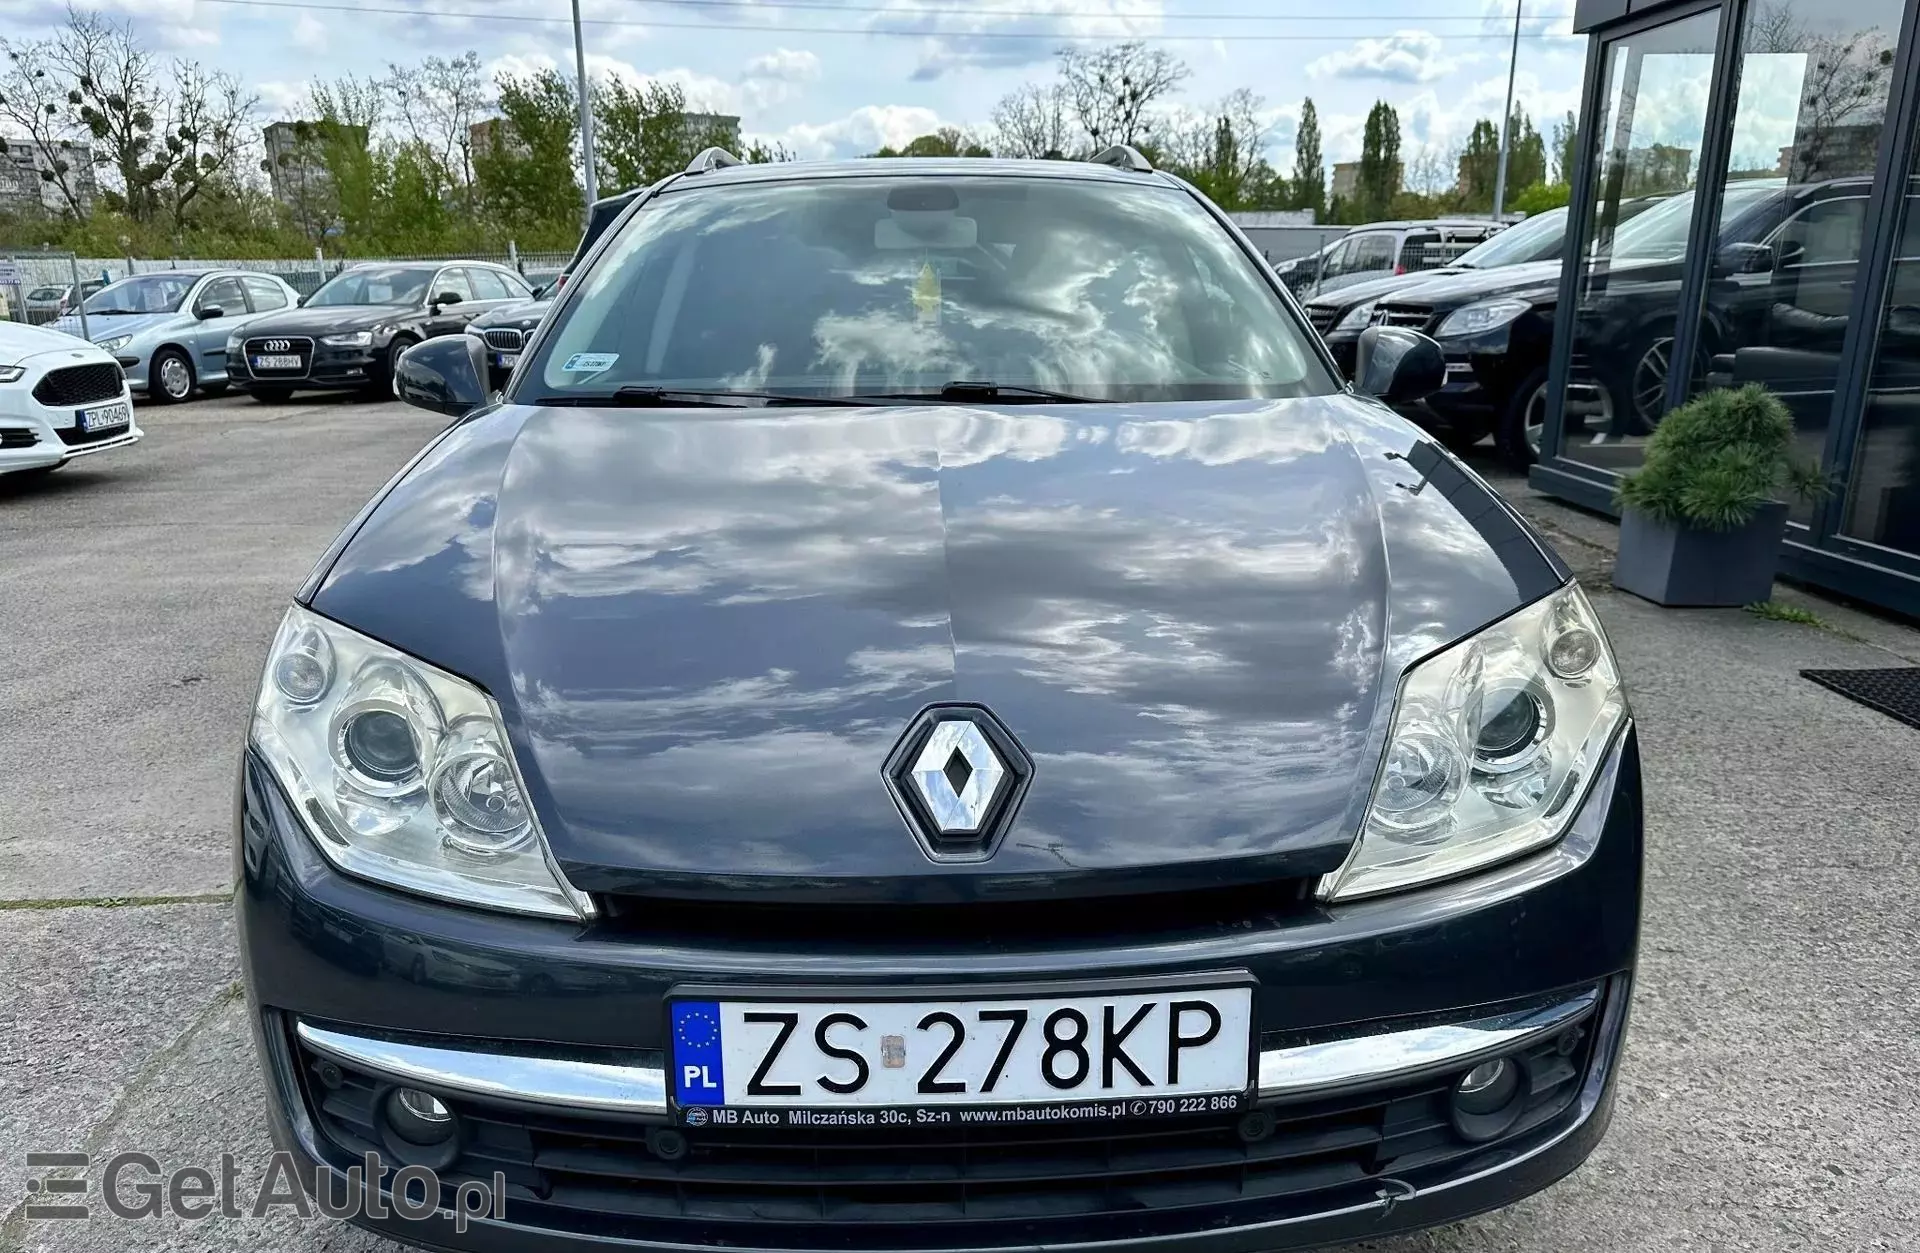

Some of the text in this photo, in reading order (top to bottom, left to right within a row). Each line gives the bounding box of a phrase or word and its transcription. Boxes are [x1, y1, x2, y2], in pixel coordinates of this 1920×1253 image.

[86, 411, 103, 427] ZPL
[743, 1000, 1222, 1095] ZS 278KP
[684, 1066, 717, 1088] PL
[713, 1110, 738, 1123] MB
[742, 1111, 779, 1124] Auto
[788, 1110, 875, 1125] Milczańska
[880, 1111, 911, 1125] 30c,
[916, 1109, 951, 1123] Sz-n
[960, 1101, 1127, 1122] www.mbautokomis.pl
[1149, 1099, 1175, 1114] 790
[1179, 1098, 1206, 1112] 222
[1210, 1095, 1237, 1110] 866
